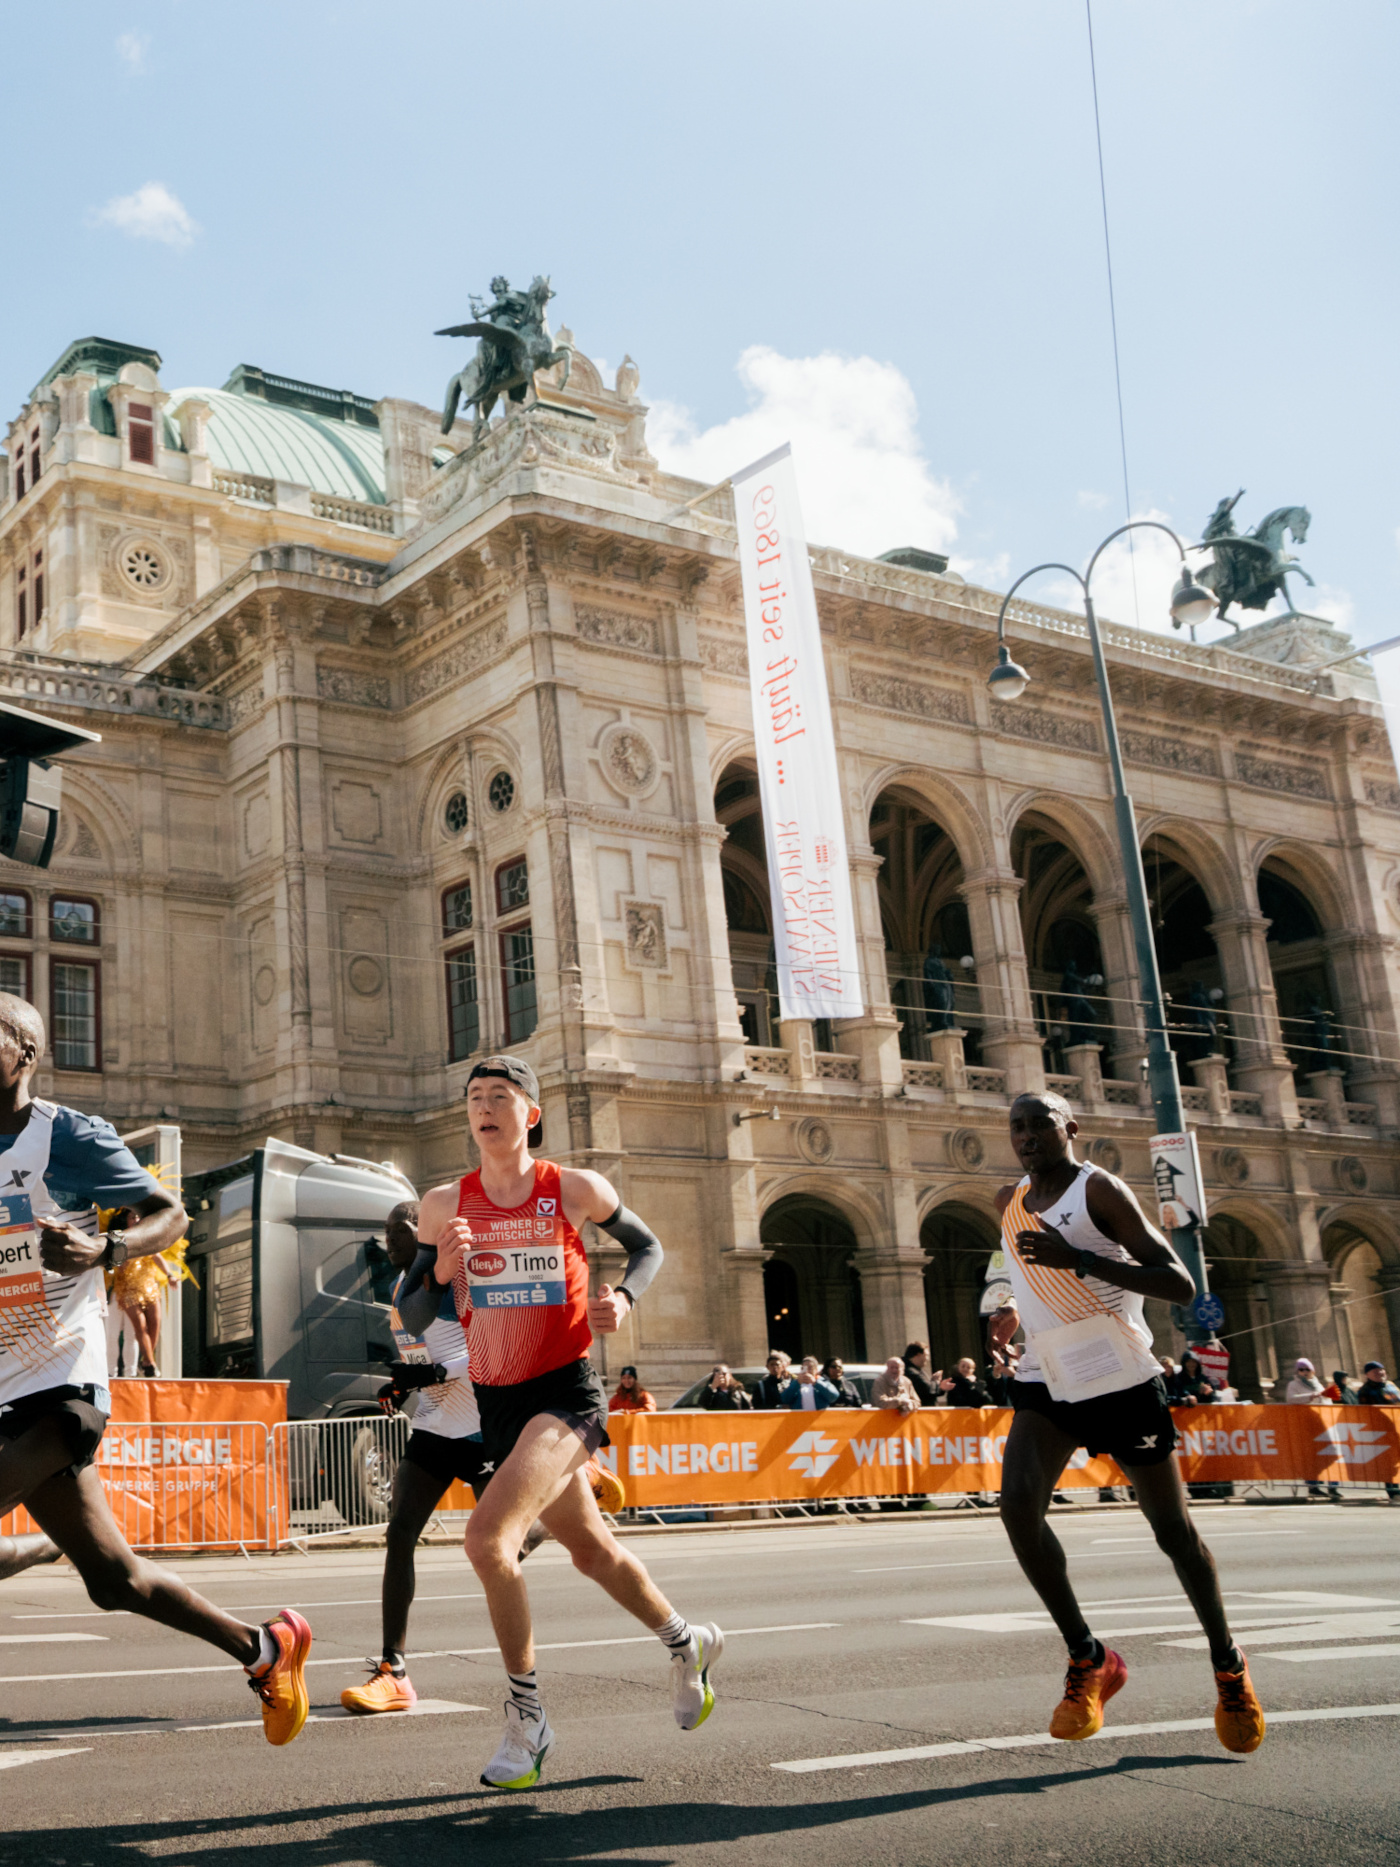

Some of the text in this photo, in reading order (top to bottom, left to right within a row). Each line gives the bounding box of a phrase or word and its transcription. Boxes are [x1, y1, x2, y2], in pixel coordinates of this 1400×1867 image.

[490, 1219, 532, 1232] WIENER
[472, 1229, 533, 1243] STÄDTISCHE
[470, 1252, 558, 1272] Hervis Timo
[486, 1290, 529, 1306] ERSTE
[102, 1437, 232, 1465] ENERGIE
[628, 1442, 758, 1476] ENERGIE
[849, 1436, 923, 1467] WIEN
[165, 1480, 218, 1492] GRUPPE
